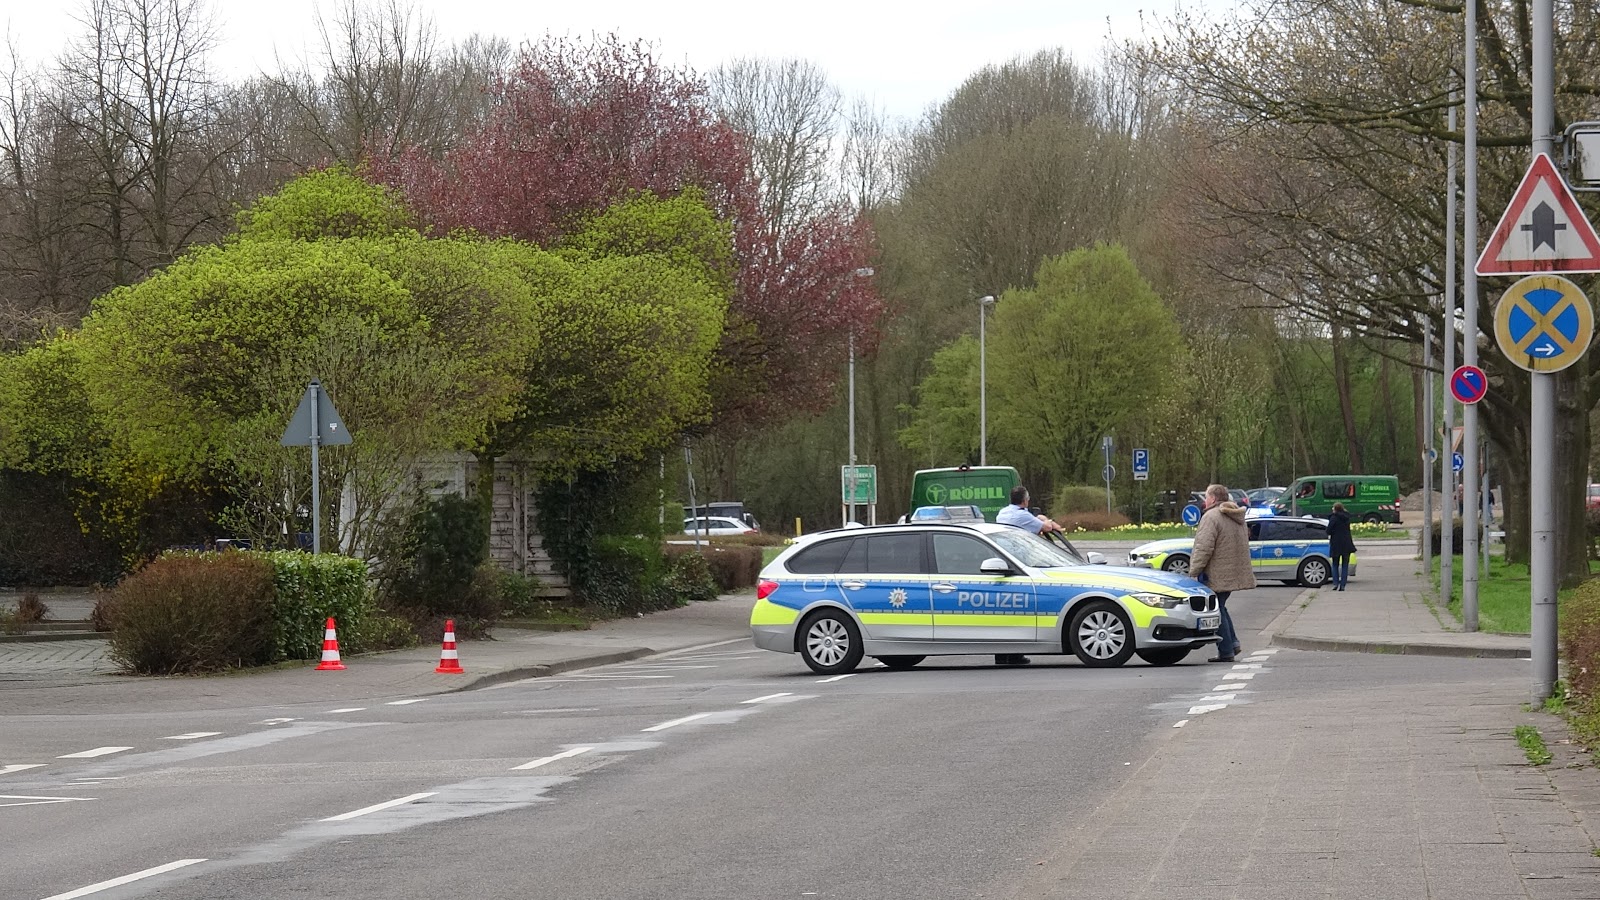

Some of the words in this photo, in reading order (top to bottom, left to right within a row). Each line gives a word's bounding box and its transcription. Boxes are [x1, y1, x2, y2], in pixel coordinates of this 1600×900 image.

[1136, 451, 1145, 463] P
[949, 485, 1005, 500] RÖHLL
[958, 591, 1029, 608] POLIZEI
